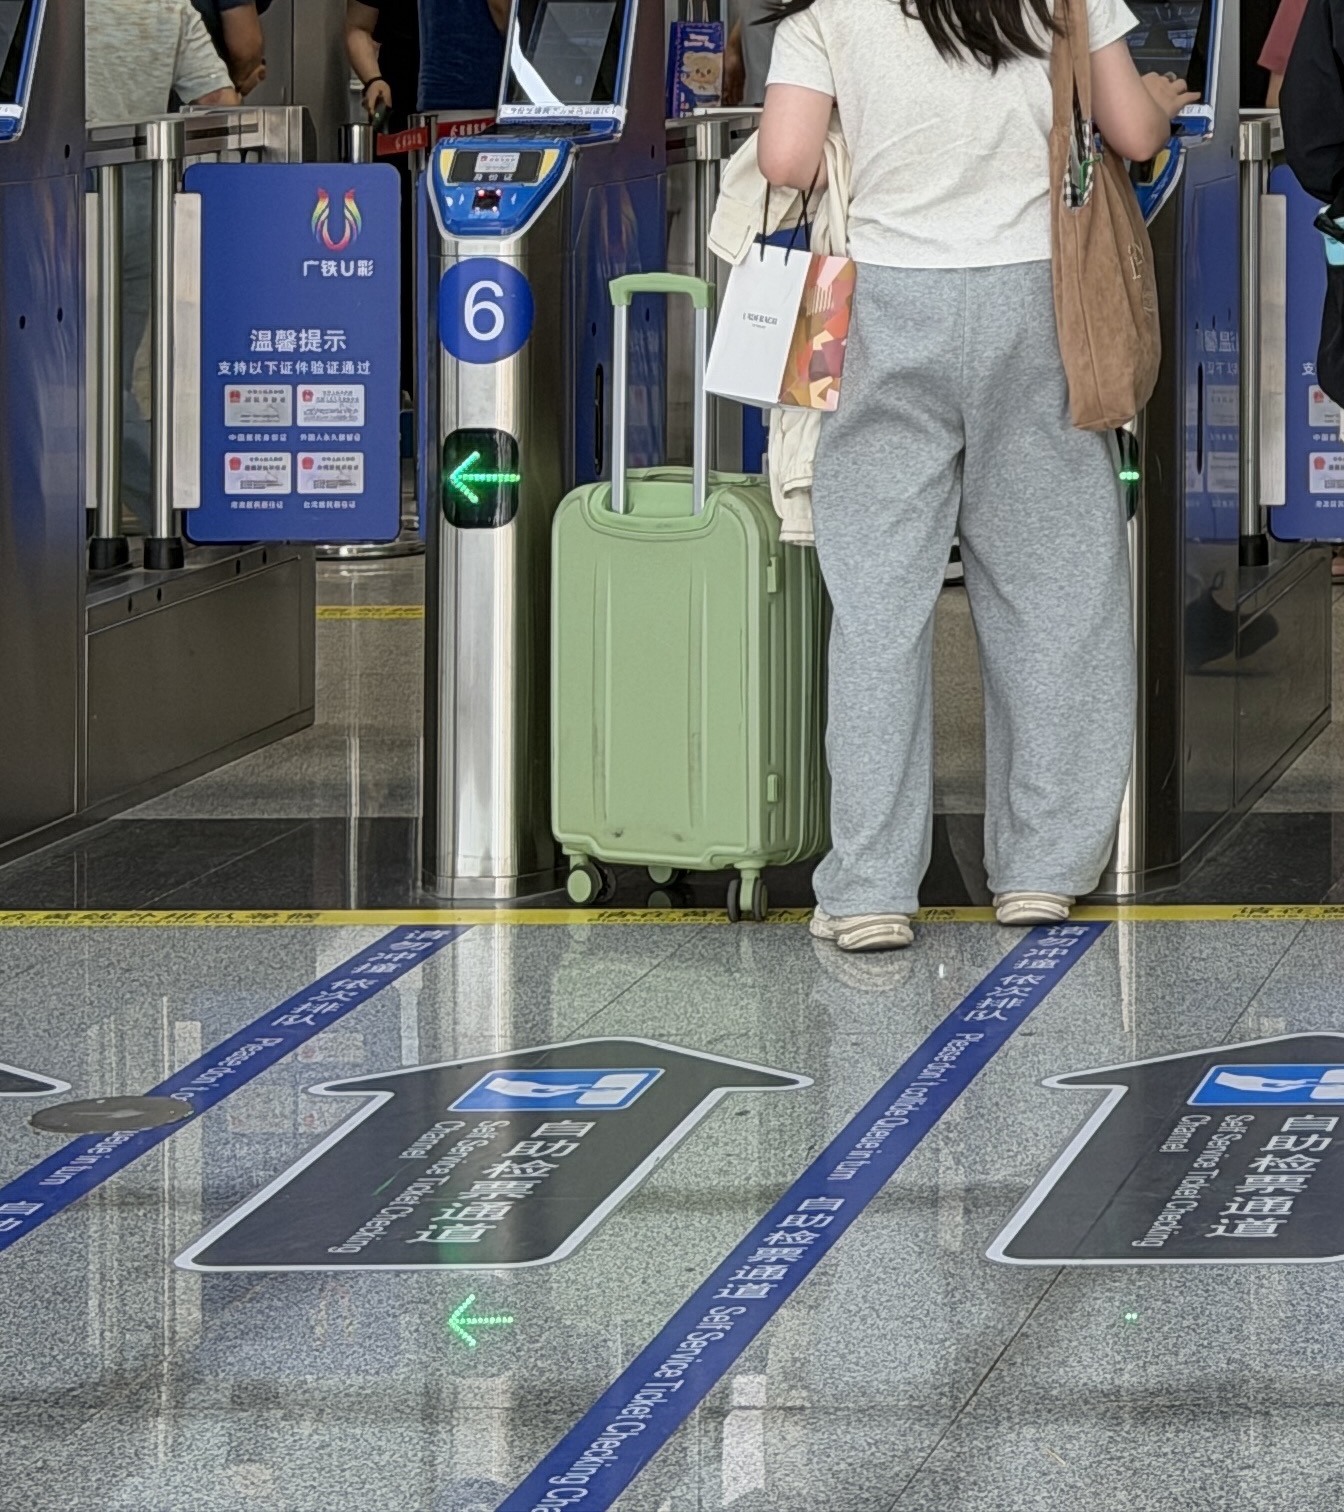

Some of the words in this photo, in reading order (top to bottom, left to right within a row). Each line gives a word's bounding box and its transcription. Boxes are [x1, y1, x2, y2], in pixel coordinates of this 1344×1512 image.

[303, 260, 374, 277] 广铁U彩
[250, 330, 347, 352] 温馨提示
[464, 280, 505, 341] 6
[217, 361, 371, 375] 支持以下证件验证通过
[405, 1119, 605, 1243] 自助检票通道
[1202, 1114, 1344, 1237] 自助检票通道
[710, 1196, 854, 1298] 自助检票通道
